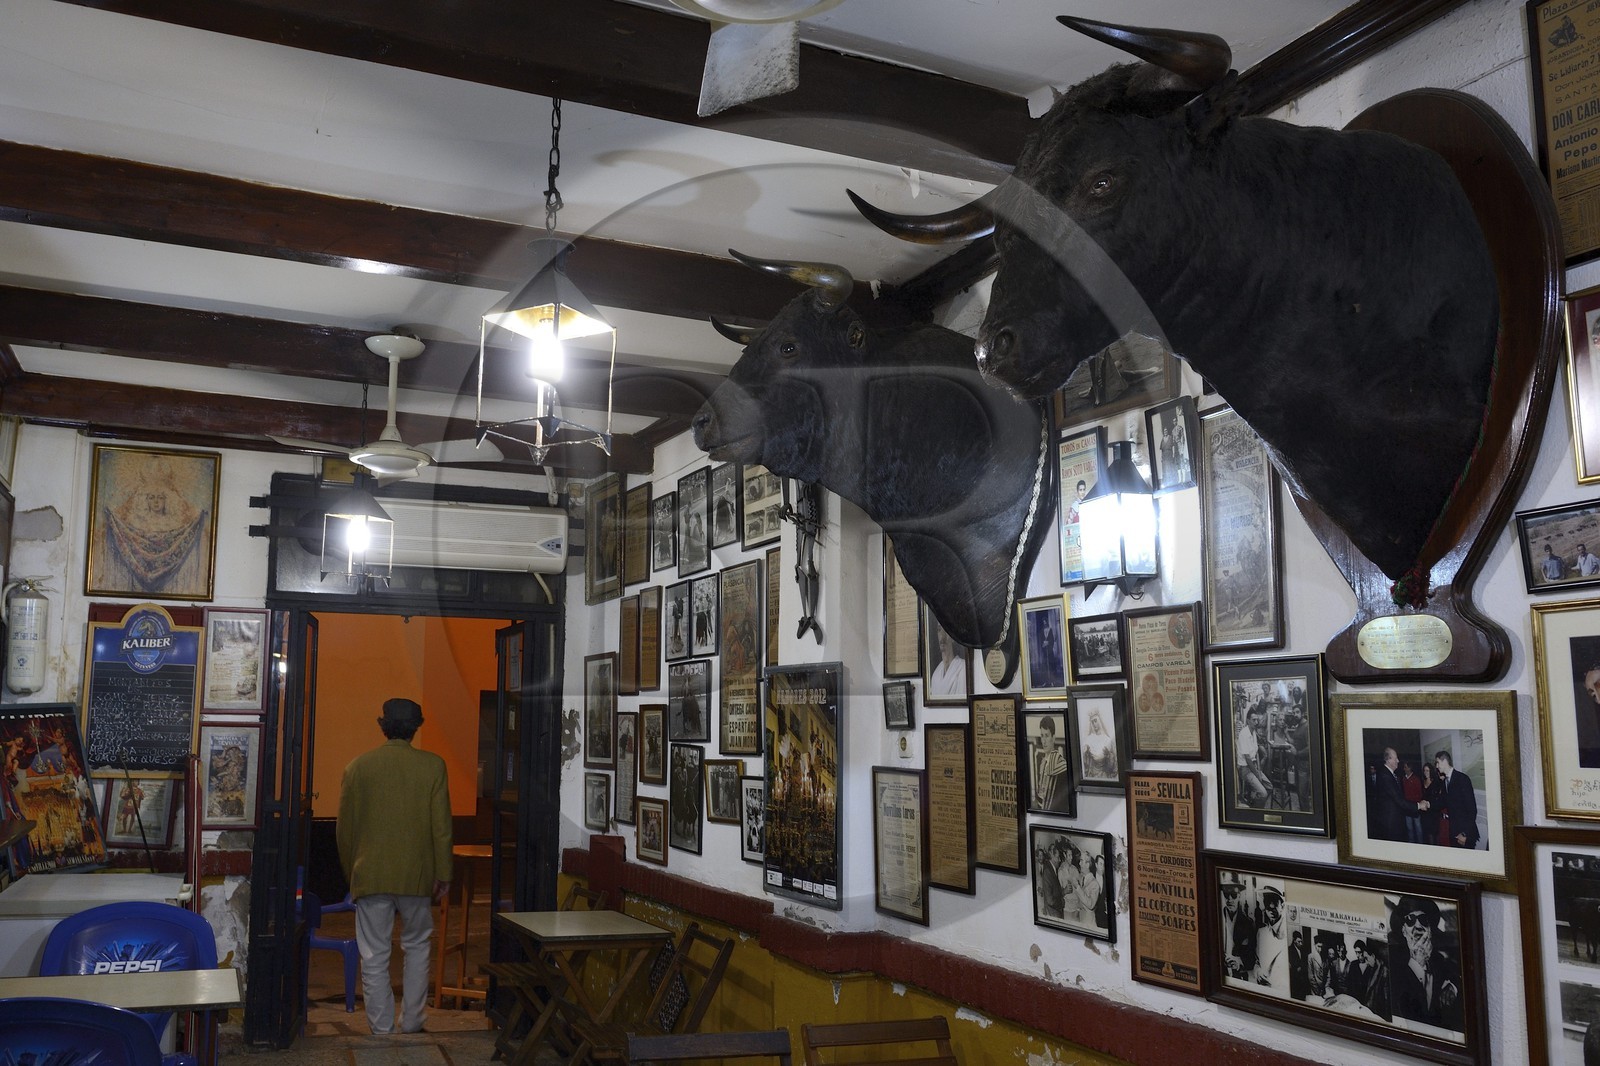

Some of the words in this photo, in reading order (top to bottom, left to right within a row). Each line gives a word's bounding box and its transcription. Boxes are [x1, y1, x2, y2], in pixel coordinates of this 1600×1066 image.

[1543, 2, 1568, 19] Plaza
[1555, 82, 1574, 92] Don
[1556, 83, 1598, 104] SANTA
[1552, 109, 1573, 131] DON
[1555, 127, 1598, 150] Antonio
[1564, 143, 1597, 161] Pepe
[1061, 443, 1075, 454] TOROS
[1081, 436, 1096, 449] CAMAS
[122, 637, 171, 650] KALIBER
[1148, 653, 1153, 661] 6
[1184, 650, 1190, 658] 6
[809, 688, 826, 705] 2012
[729, 704, 745, 715] ORTEGA
[729, 736, 742, 747] JUAN
[88, 753, 117, 762] LOMO
[141, 755, 177, 765] QUESO
[991, 784, 1017, 801] ROMERO
[1157, 782, 1191, 800] SEVILLA
[1151, 853, 1157, 863] EL
[1160, 855, 1193, 868] CORDOBES
[1147, 881, 1195, 900] MONTILLA
[1138, 896, 1148, 909] EL
[1149, 898, 1196, 918] CORDOBES
[1300, 906, 1328, 917] JOSELITO
[1161, 914, 1196, 932] SOARES
[94, 959, 162, 975] PEPSI
